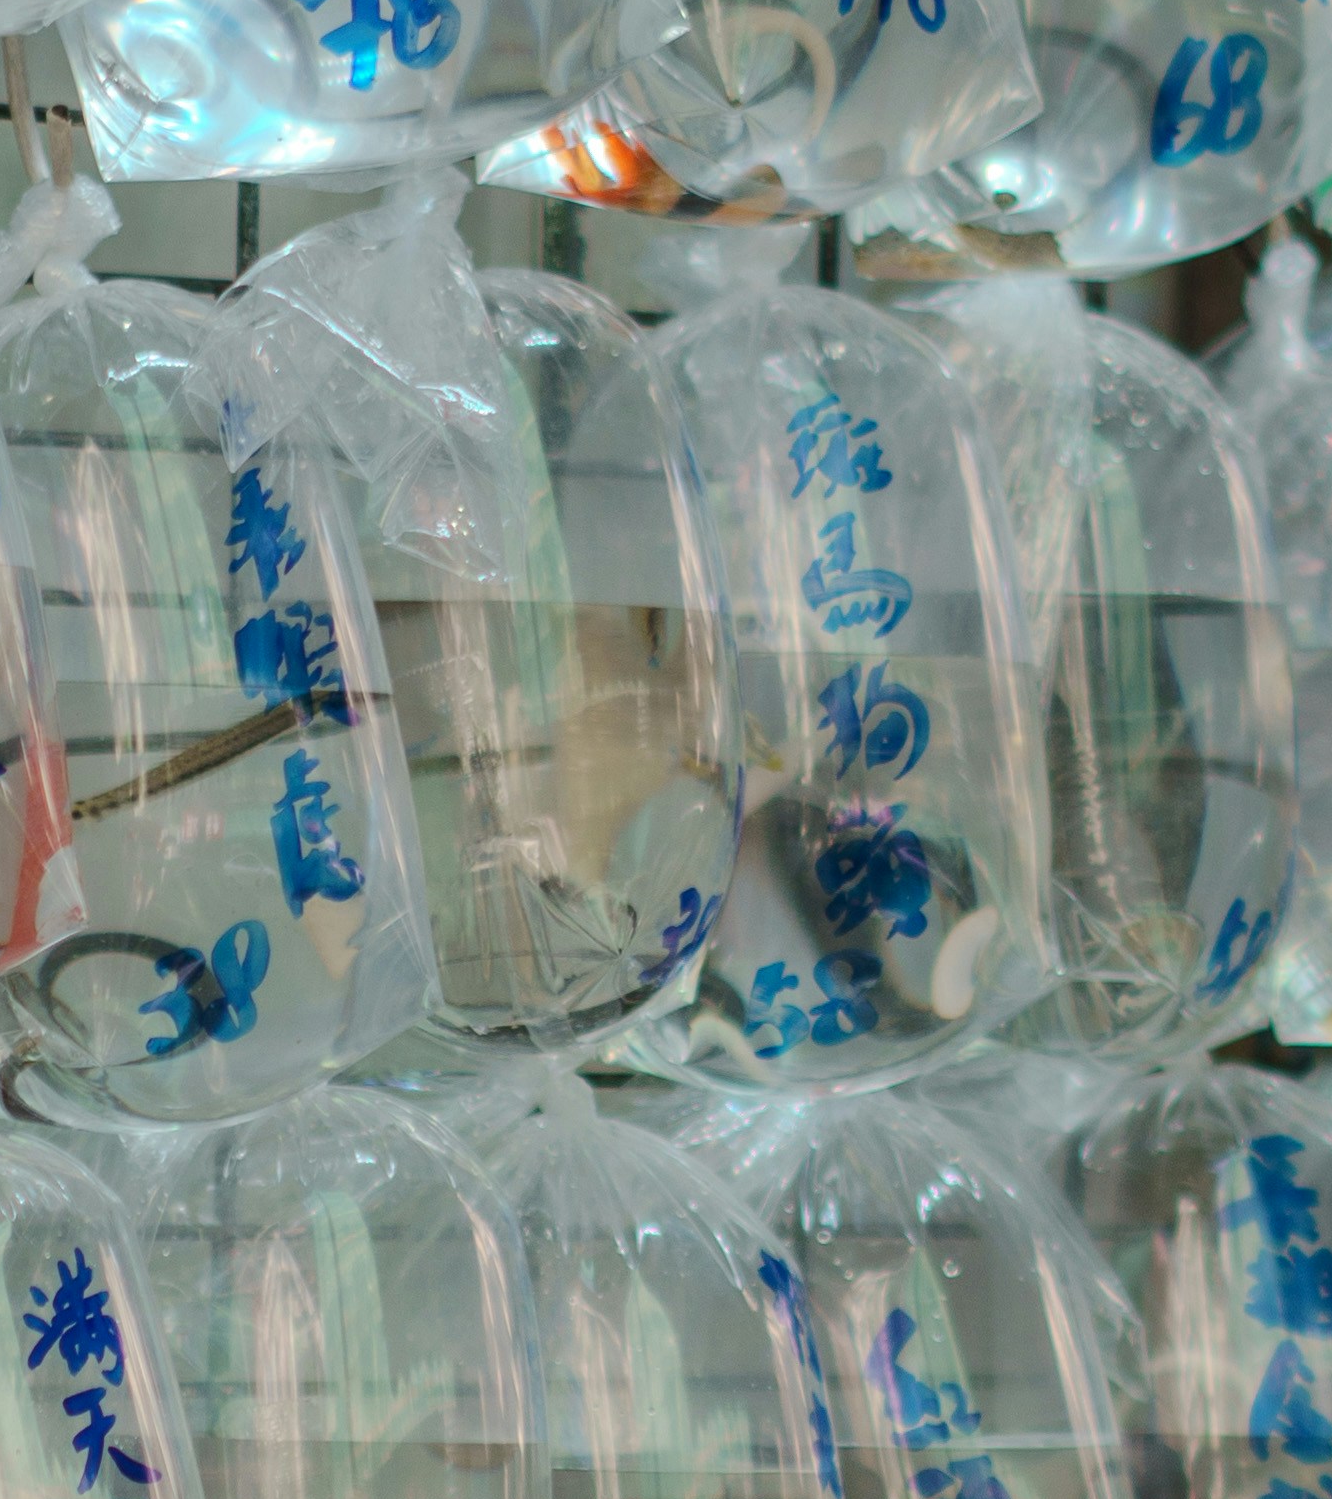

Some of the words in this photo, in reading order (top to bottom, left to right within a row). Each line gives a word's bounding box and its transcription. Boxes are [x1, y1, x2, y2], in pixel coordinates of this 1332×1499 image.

[1151, 31, 1268, 167] 68
[139, 919, 270, 1055] 38
[744, 948, 882, 1059] 58
